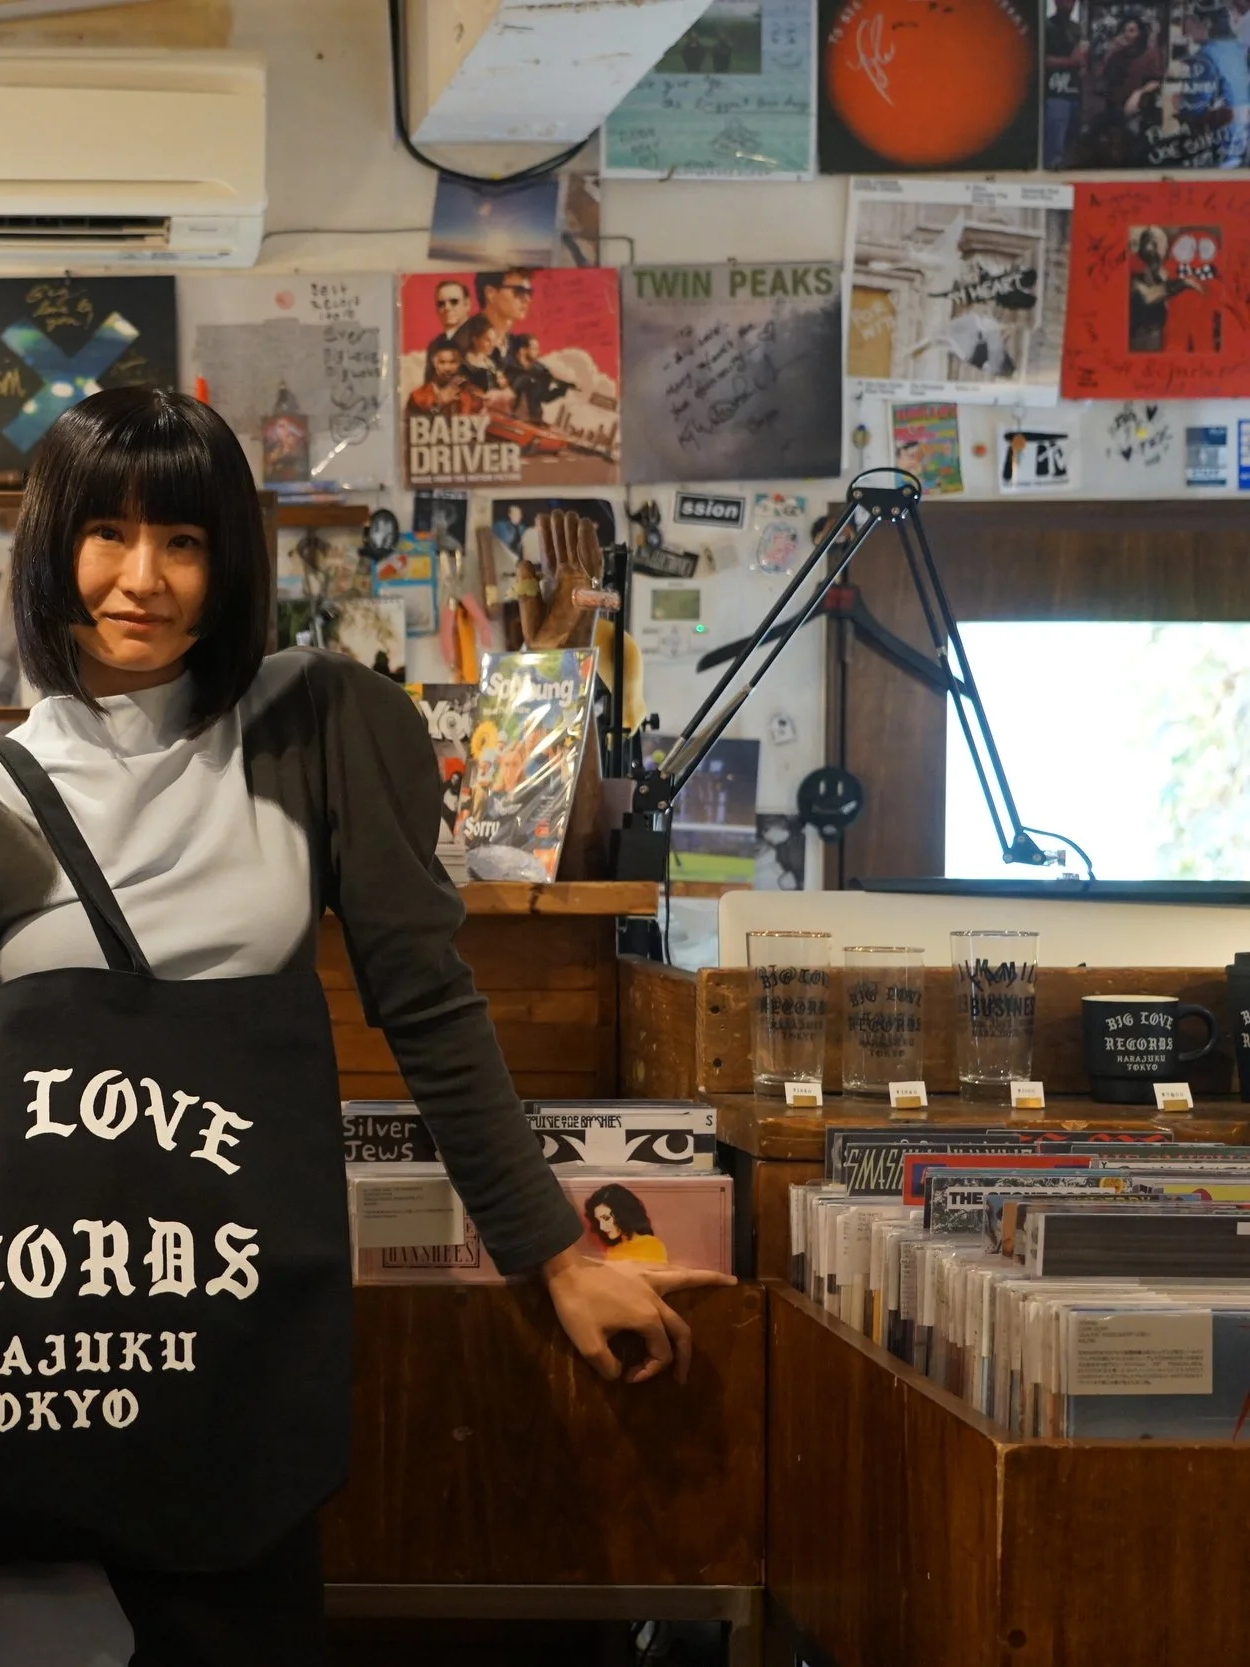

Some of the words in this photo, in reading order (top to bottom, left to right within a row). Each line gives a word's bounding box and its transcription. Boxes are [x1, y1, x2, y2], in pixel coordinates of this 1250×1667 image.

[632, 269, 712, 299] TWIN
[729, 267, 833, 298] PEAKS
[409, 415, 491, 444] BABY
[410, 442, 522, 475] DRIVER
[681, 500, 739, 519] ssion
[463, 818, 500, 841] Sorry
[1105, 1012, 1134, 1032] BIG
[1140, 1011, 1174, 1031] LOVE
[1104, 1037, 1174, 1051] RECORDS
[1117, 1054, 1166, 1063] HARAJUKU
[1126, 1063, 1158, 1071] TOKYO
[23, 1067, 254, 1175] LOVE
[342, 1115, 417, 1138] Silver
[344, 1141, 414, 1162] Jews
[949, 1191, 984, 1205] THE
